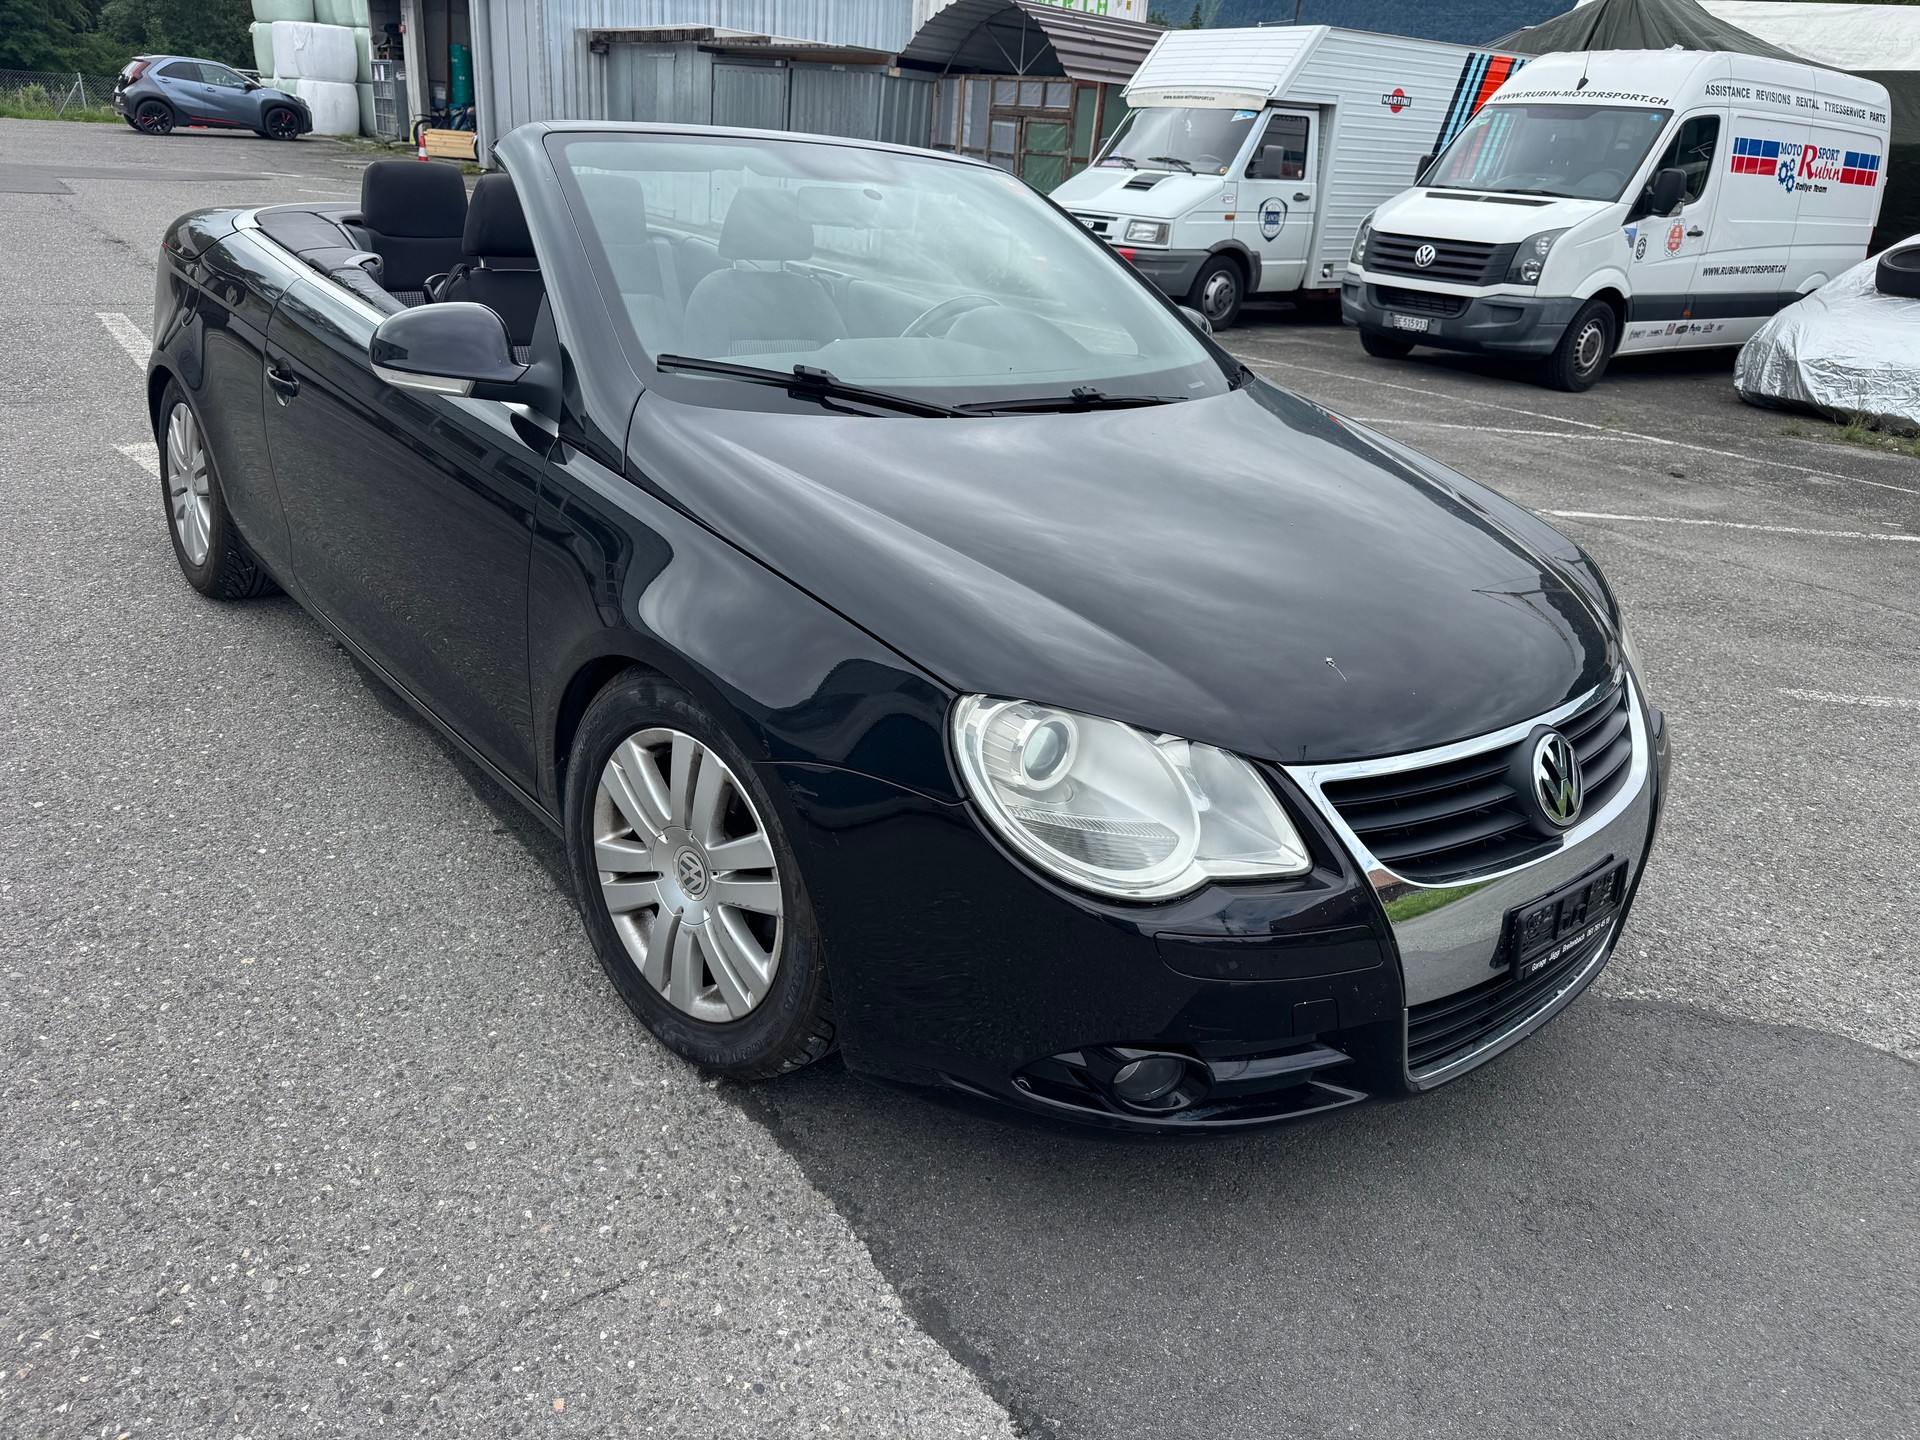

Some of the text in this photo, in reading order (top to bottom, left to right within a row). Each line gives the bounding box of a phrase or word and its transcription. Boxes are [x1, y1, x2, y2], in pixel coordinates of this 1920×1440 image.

[1382, 95, 1411, 106] MARTINI
[1494, 90, 1669, 106] WWW.RUBIN-MOTORSPORT.CH
[1705, 84, 1886, 124] ASSISTANCE REVISIONS RENTAL TYRESSERVICE PARTS
[1780, 142, 1840, 161] MOTO SPORT
[1797, 144, 1840, 182] Rubin
[1794, 182, 1828, 193] Rallye Team
[1702, 264, 1787, 277] WWW.RUBIN-MOTORSPORT.CH
[1531, 958, 1547, 972] Garage
